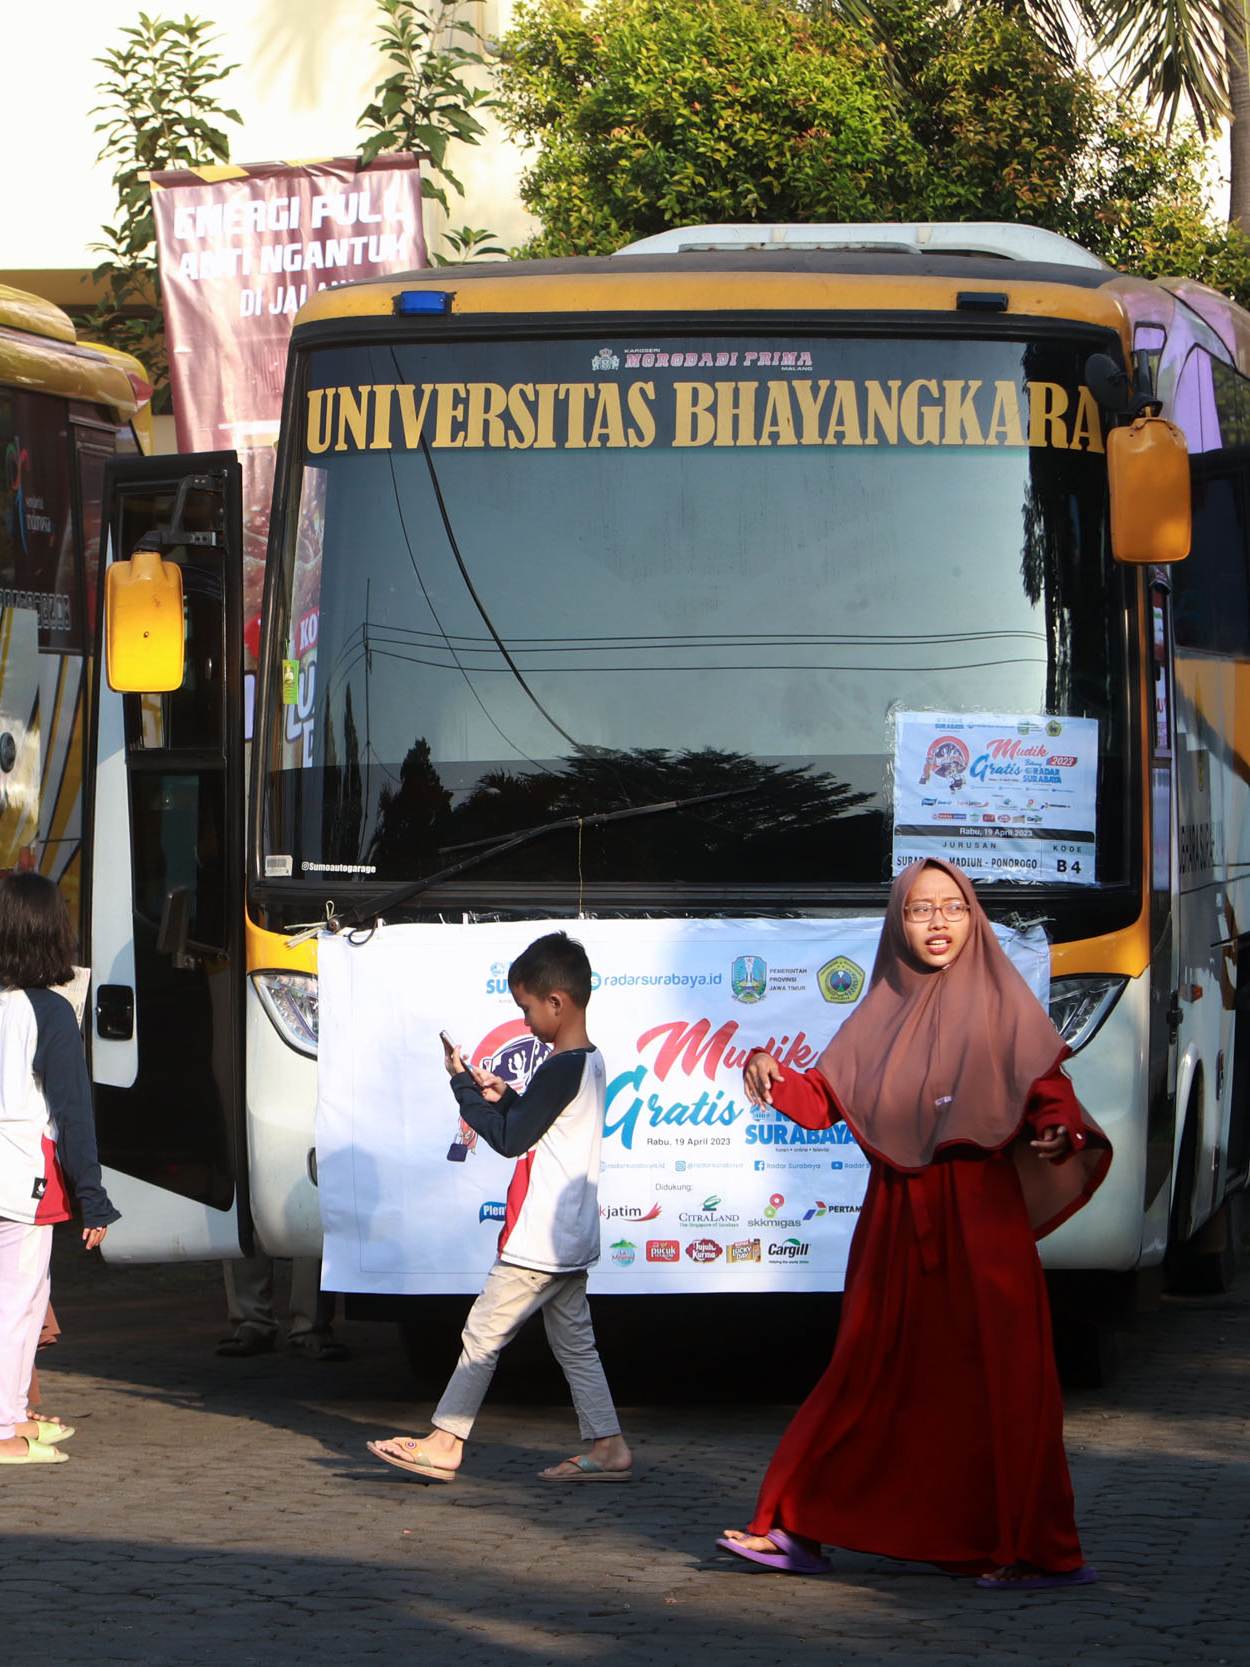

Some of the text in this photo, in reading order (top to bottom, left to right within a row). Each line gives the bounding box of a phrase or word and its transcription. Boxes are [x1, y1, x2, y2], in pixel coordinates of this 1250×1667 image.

[174, 196, 300, 240] ENERGI
[180, 233, 410, 280] ANTI NGANTUK
[240, 290, 262, 317] DI
[624, 352, 813, 368] MORODADI PRIMA
[306, 379, 1106, 454] UNIVERSITAS BHAYANGKARA
[986, 738, 1049, 760] Mudik
[969, 753, 1023, 782] Gratis
[1051, 756, 1074, 766] 2023
[959, 827, 1033, 838] Rabu, 19 April 2023
[942, 841, 1082, 853] JURUSAN KODE
[949, 857, 982, 868] MADIUN
[991, 858, 1038, 870] PONOROGO
[1056, 860, 1067, 873] B
[1071, 861, 1082, 874] 4
[604, 972, 722, 989] radarsurabaya.id
[647, 1138, 672, 1146] Rabu,
[687, 1137, 708, 1147] April
[711, 1137, 731, 1145] 2023
[766, 1161, 788, 1169] Radar
[789, 1161, 821, 1171] Surabaya
[844, 1161, 865, 1169] Radar
[655, 1183, 694, 1193] Didukung:
[483, 1205, 507, 1216] Plen
[747, 1219, 801, 1229] skkmigas
[651, 1246, 676, 1257] pucuk
[768, 1243, 809, 1258] Cargill
